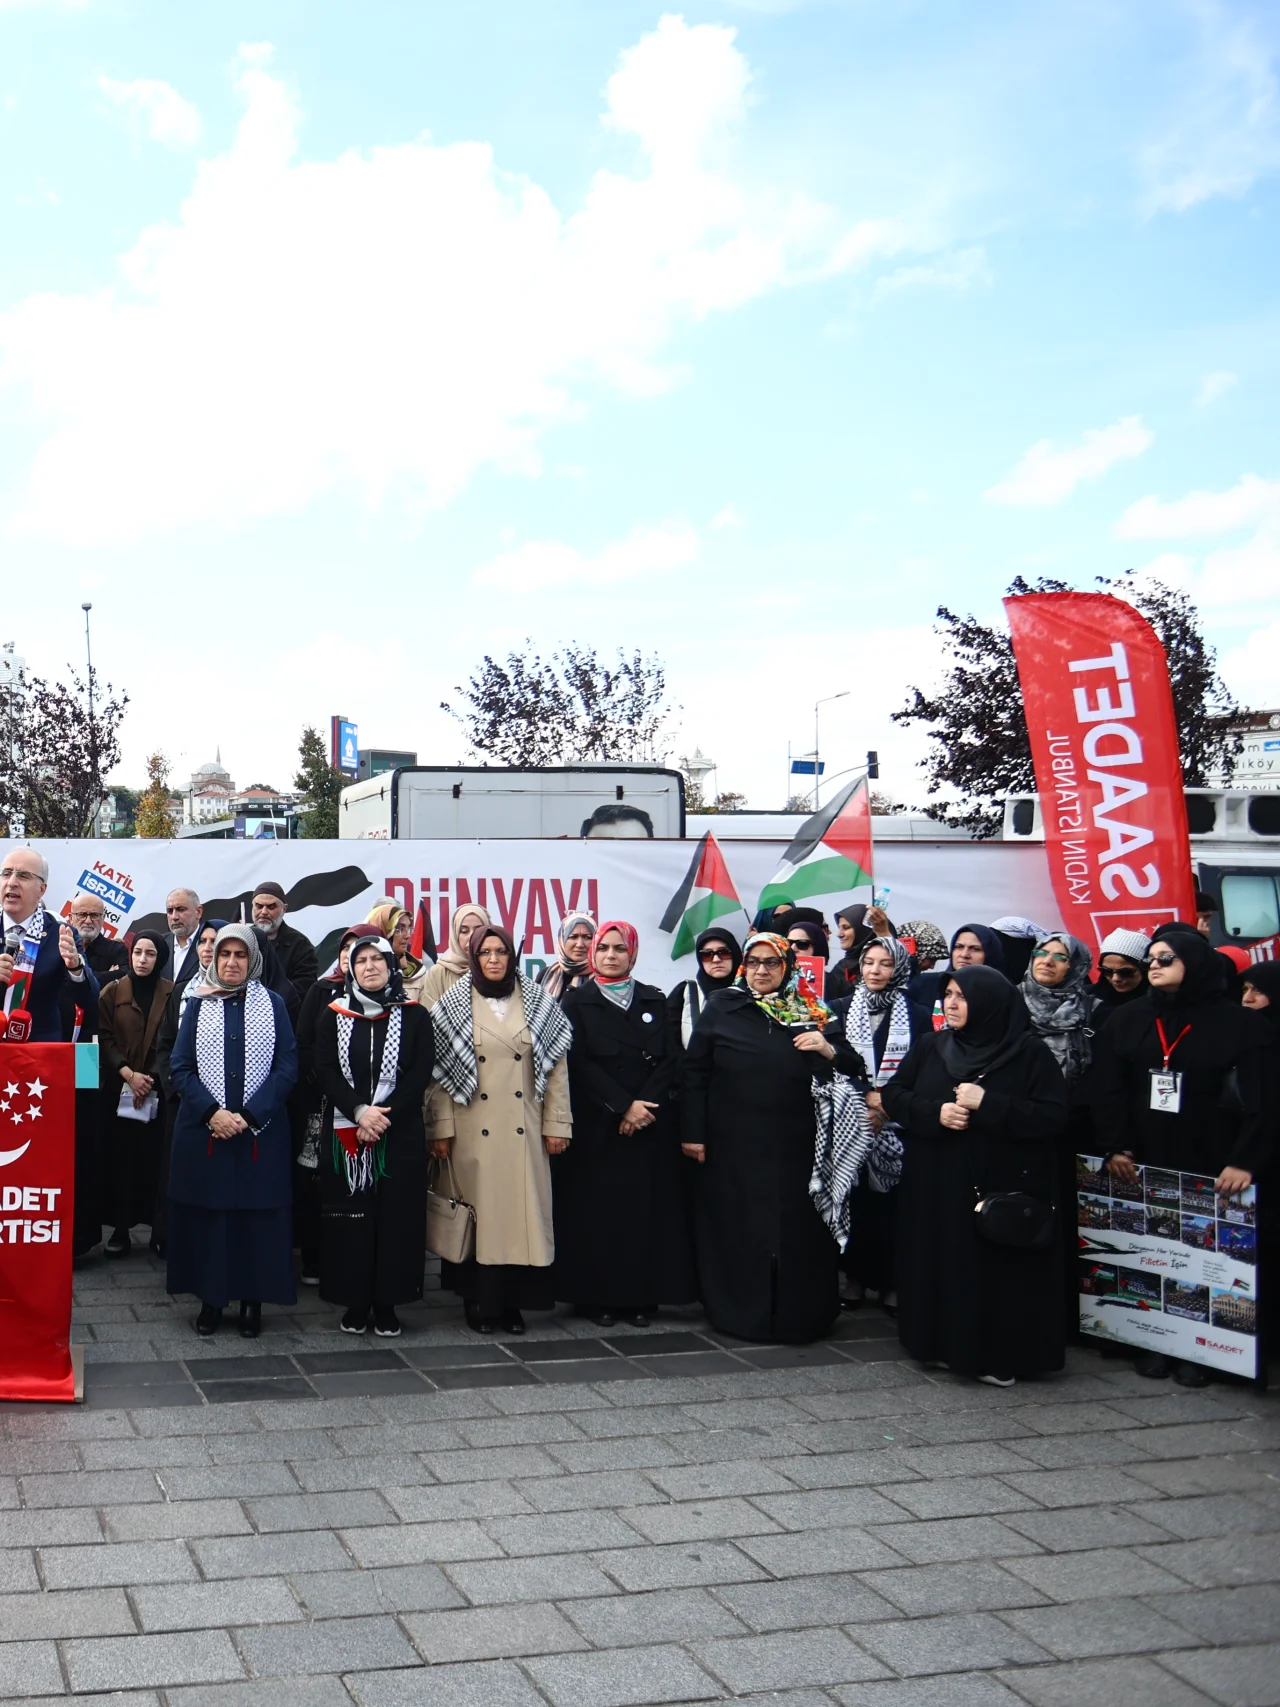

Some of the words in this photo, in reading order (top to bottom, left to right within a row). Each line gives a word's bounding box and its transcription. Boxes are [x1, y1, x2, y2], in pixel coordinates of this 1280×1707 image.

[1213, 758, 1274, 770] Kdıköy
[93, 860, 134, 892] KATİL
[82, 872, 127, 909] İSRAİL
[1140, 1257, 1168, 1267] Filistin
[1170, 1258, 1188, 1269] İçin
[1207, 1340, 1244, 1354] SAADET
